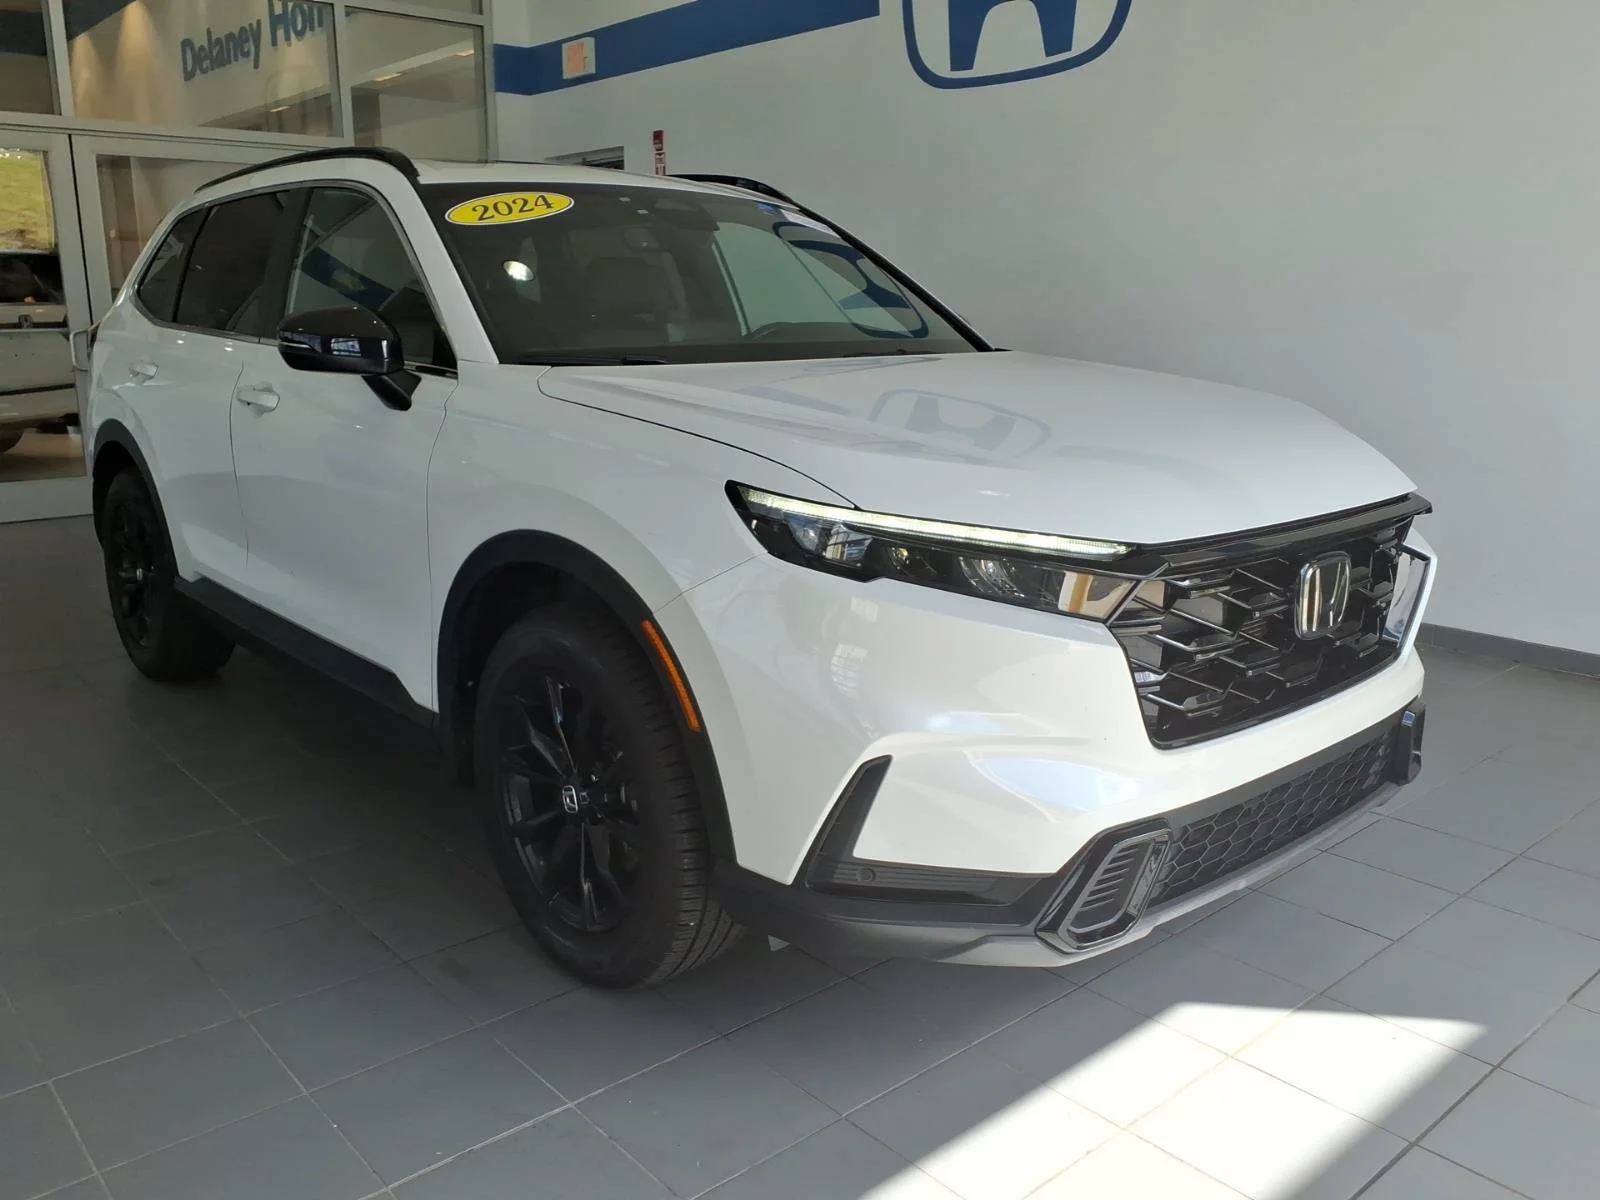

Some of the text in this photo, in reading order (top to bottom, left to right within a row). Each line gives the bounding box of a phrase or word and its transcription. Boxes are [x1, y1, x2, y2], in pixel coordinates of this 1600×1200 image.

[181, 0, 325, 82] Delaney Hon
[472, 194, 554, 221] 2024
